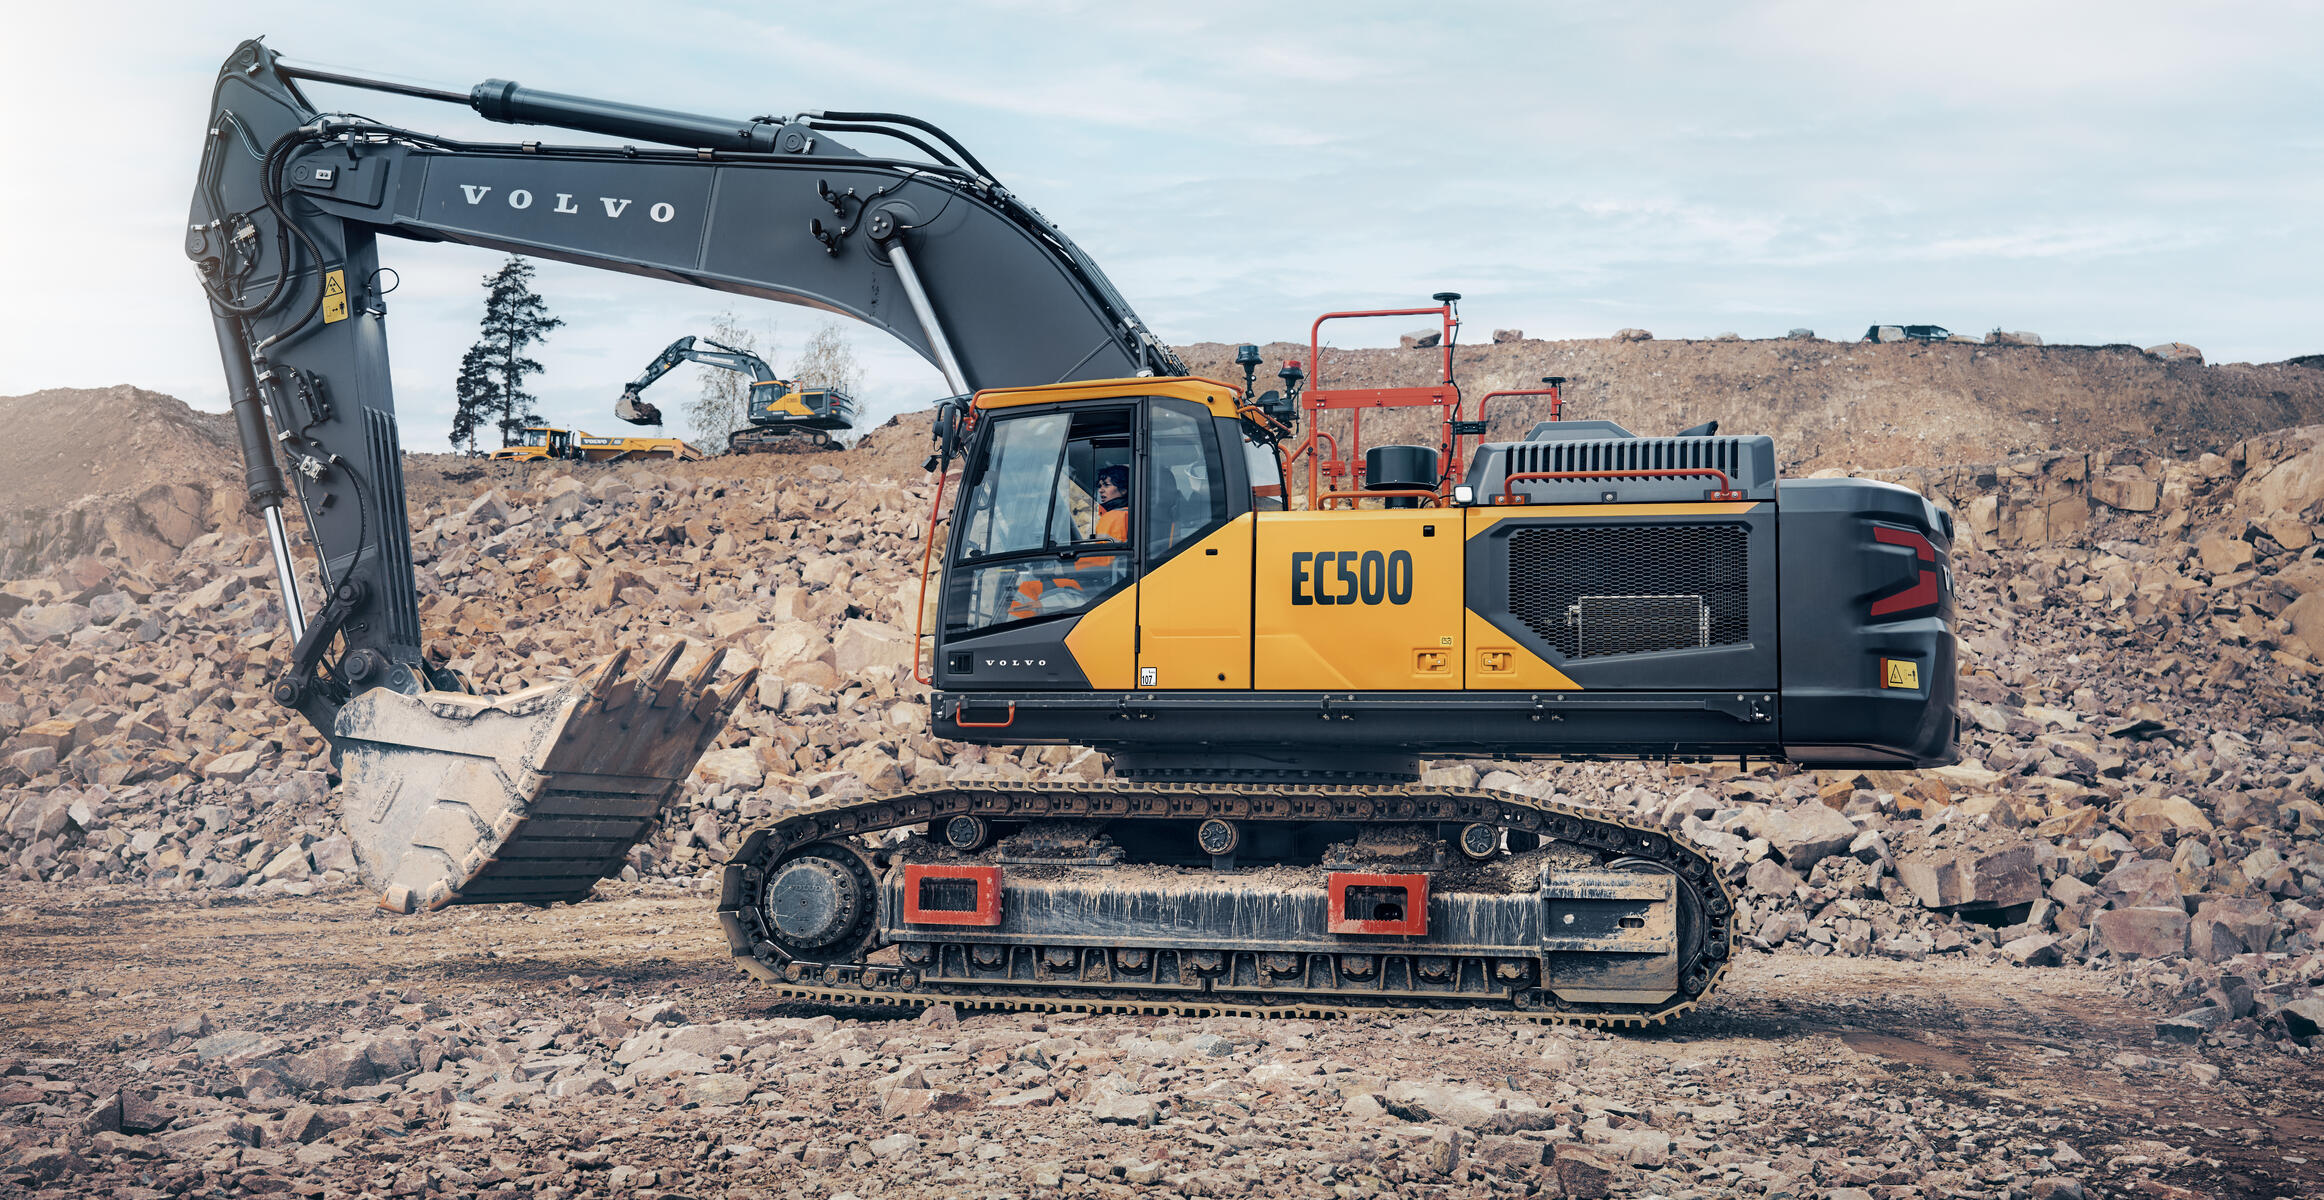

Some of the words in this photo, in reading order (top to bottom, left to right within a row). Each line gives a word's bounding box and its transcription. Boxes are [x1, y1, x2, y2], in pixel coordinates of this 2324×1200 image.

[460, 184, 675, 223] VOLVO
[1292, 550, 1413, 606] EC500
[1141, 675, 1153, 685] 107
